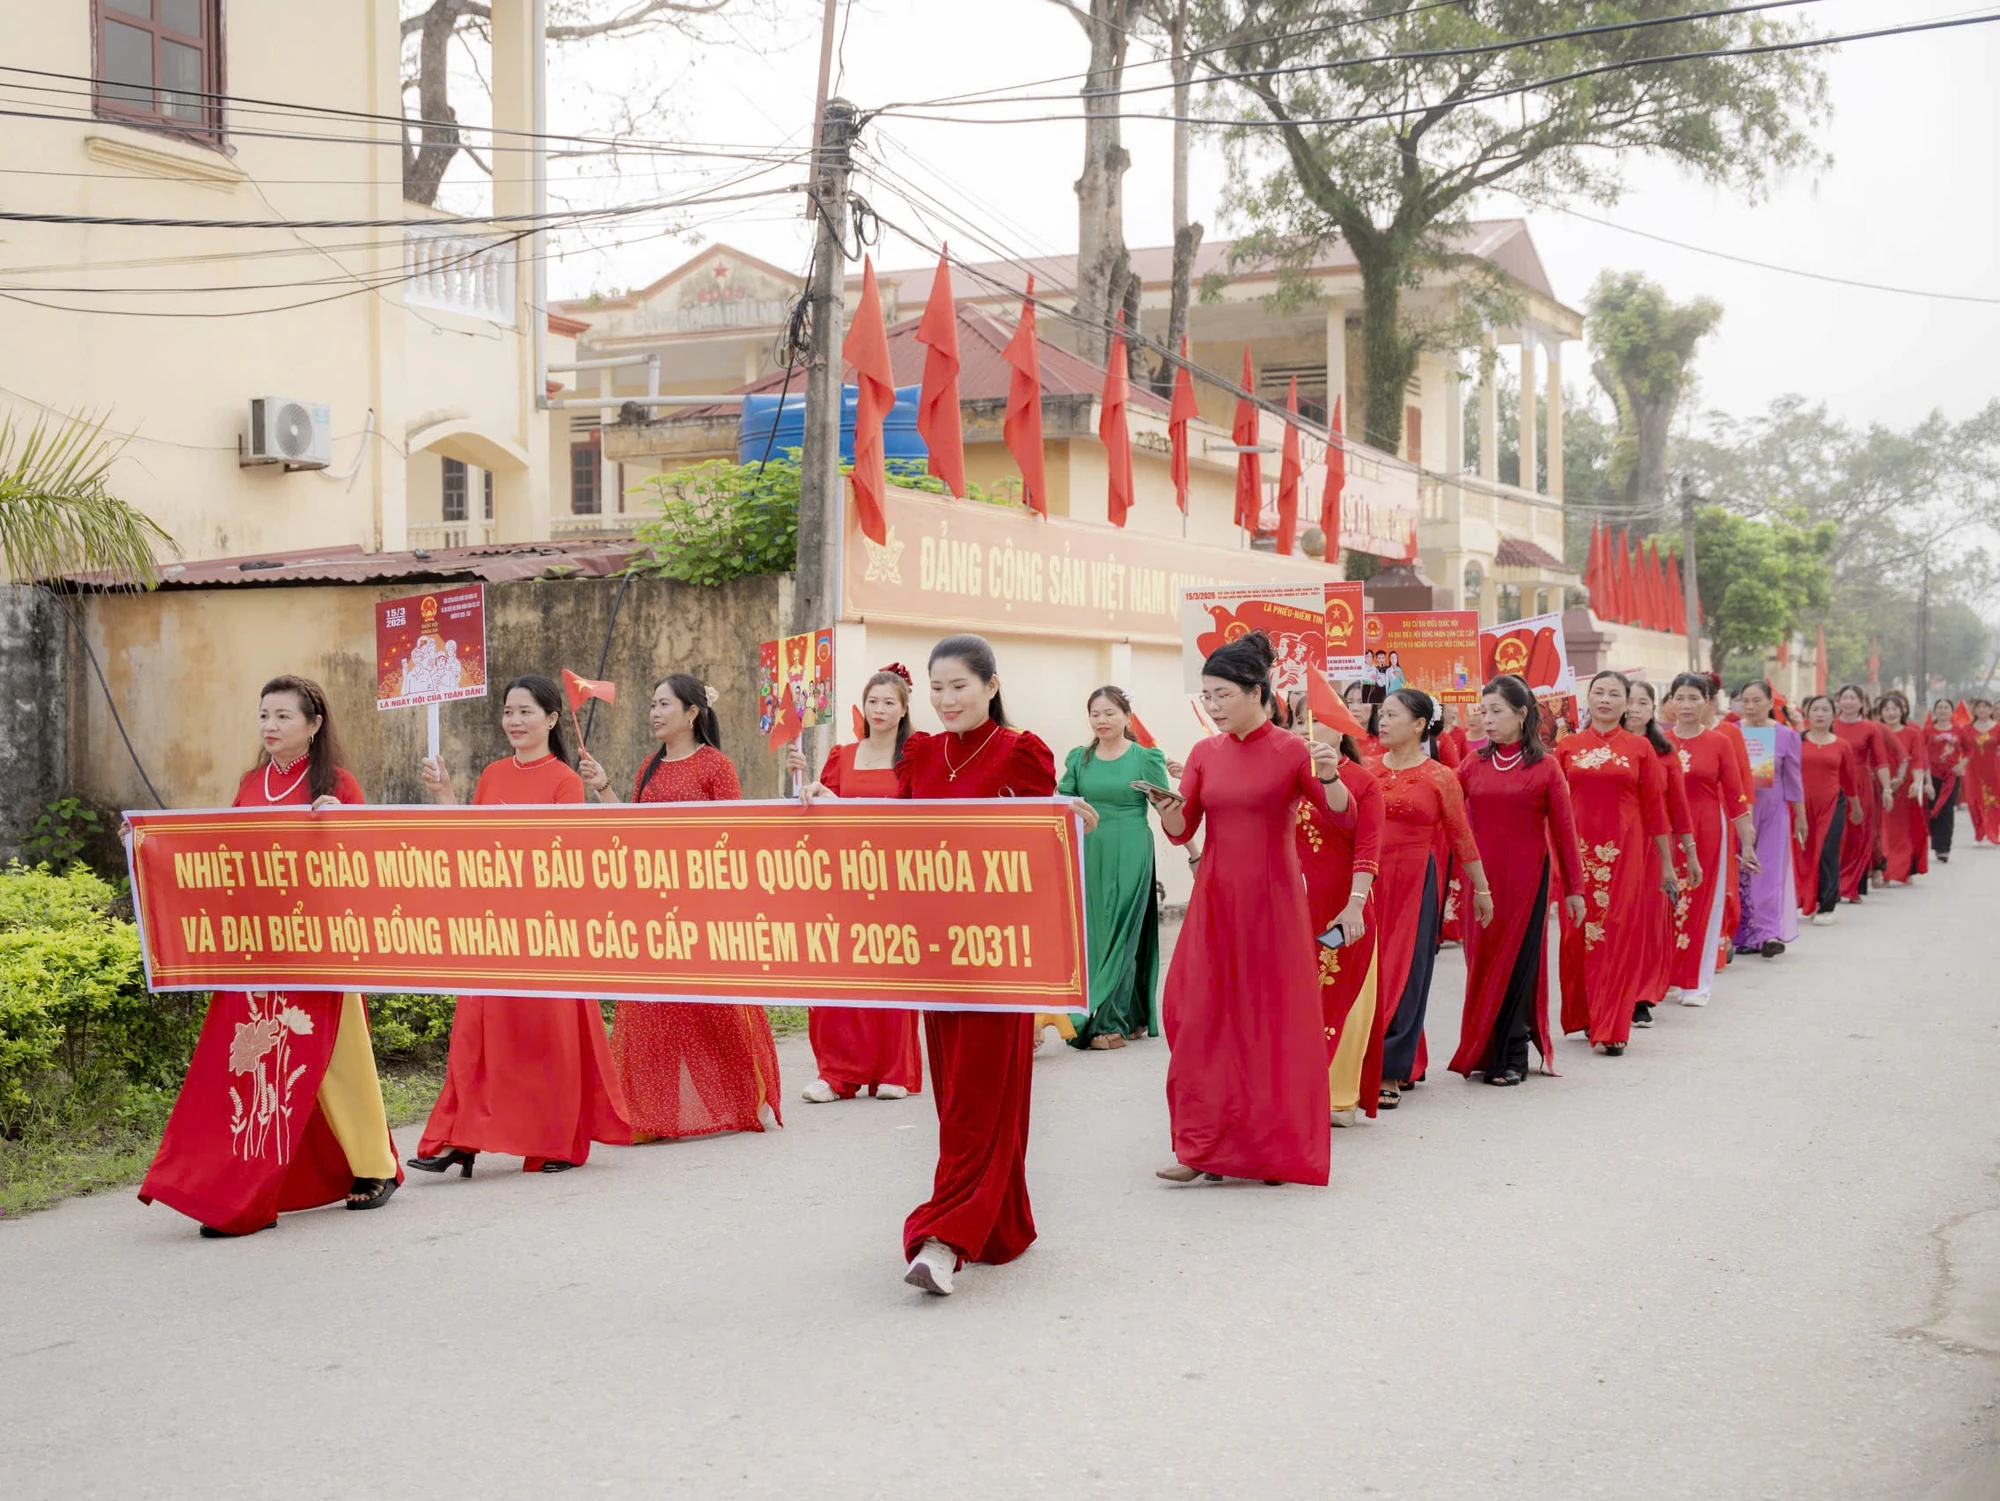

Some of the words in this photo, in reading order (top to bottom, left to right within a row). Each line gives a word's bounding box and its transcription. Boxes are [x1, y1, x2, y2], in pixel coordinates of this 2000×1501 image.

[920, 520, 982, 596] ĐẢNG
[988, 537, 1043, 612] CỘNG
[1049, 540, 1087, 607] SẢN
[1091, 553, 1126, 620] VIỆT
[1130, 566, 1166, 614] NAM
[1185, 592, 1216, 600] 15/3/2026
[385, 607, 406, 618] 15/3
[1312, 615, 1324, 625] TIN
[386, 618, 406, 628] 2026
[391, 698, 411, 707] NGÀY
[413, 696, 425, 704] HỘI
[427, 693, 441, 701] CỦA
[444, 690, 463, 699] TOÀN
[465, 687, 484, 697] DÂN!
[174, 843, 246, 896] NHIỆT
[250, 843, 298, 896] LIỆT
[305, 843, 370, 889] CHÀO
[376, 841, 451, 888] MỪNG
[457, 841, 524, 888] NGÀY
[532, 835, 584, 889] BẦU
[592, 835, 628, 890] CỬ
[634, 849, 679, 899] ĐẠI
[687, 832, 748, 891] BIỂU
[756, 835, 832, 896] QUỐC
[840, 841, 888, 900] HỘI
[897, 841, 975, 893] KHÓA
[983, 851, 1032, 893] XVI
[181, 909, 216, 953] VÀ
[222, 916, 263, 961] ĐẠI
[268, 900, 322, 953] BIỂU
[327, 909, 370, 962] HỘI
[374, 903, 441, 955] ĐỒNG
[450, 910, 519, 957] NHÂN
[526, 911, 579, 959] DÂN
[586, 911, 639, 959] CÁC
[646, 906, 698, 960] CẤP
[707, 913, 798, 971] NHIỆM
[806, 913, 840, 964] KỲ
[850, 923, 920, 965] 2026
[929, 943, 940, 952] -
[948, 925, 1031, 968] 2031!
